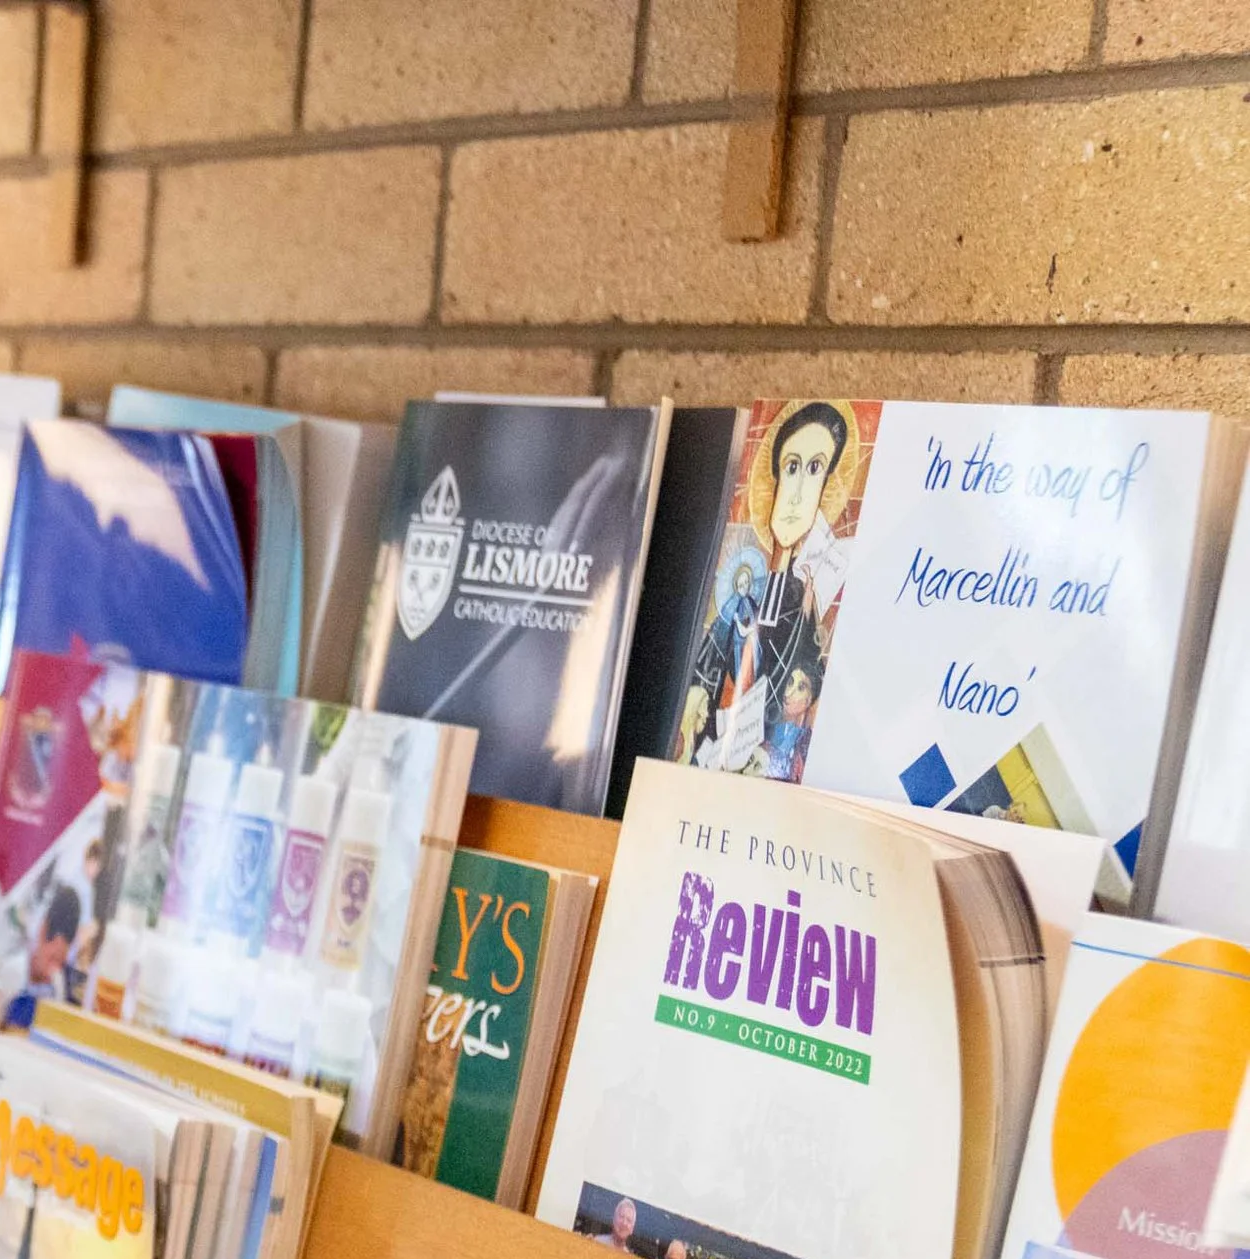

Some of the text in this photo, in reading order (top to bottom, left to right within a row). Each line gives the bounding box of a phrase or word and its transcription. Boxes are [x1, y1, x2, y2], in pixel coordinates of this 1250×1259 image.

[963, 433, 1014, 494] the
[1025, 462, 1092, 517] way
[1100, 443, 1150, 520] of
[462, 543, 593, 592] LISMORE
[472, 519, 534, 546] DIOCESE
[896, 548, 1038, 608] Marcellin
[1050, 556, 1122, 616] and
[679, 820, 876, 898] THE PROVINCE
[434, 887, 530, 996] Y'S
[664, 871, 876, 1035] Review
[674, 1004, 864, 1077] NO.9 OCTOBER 2022
